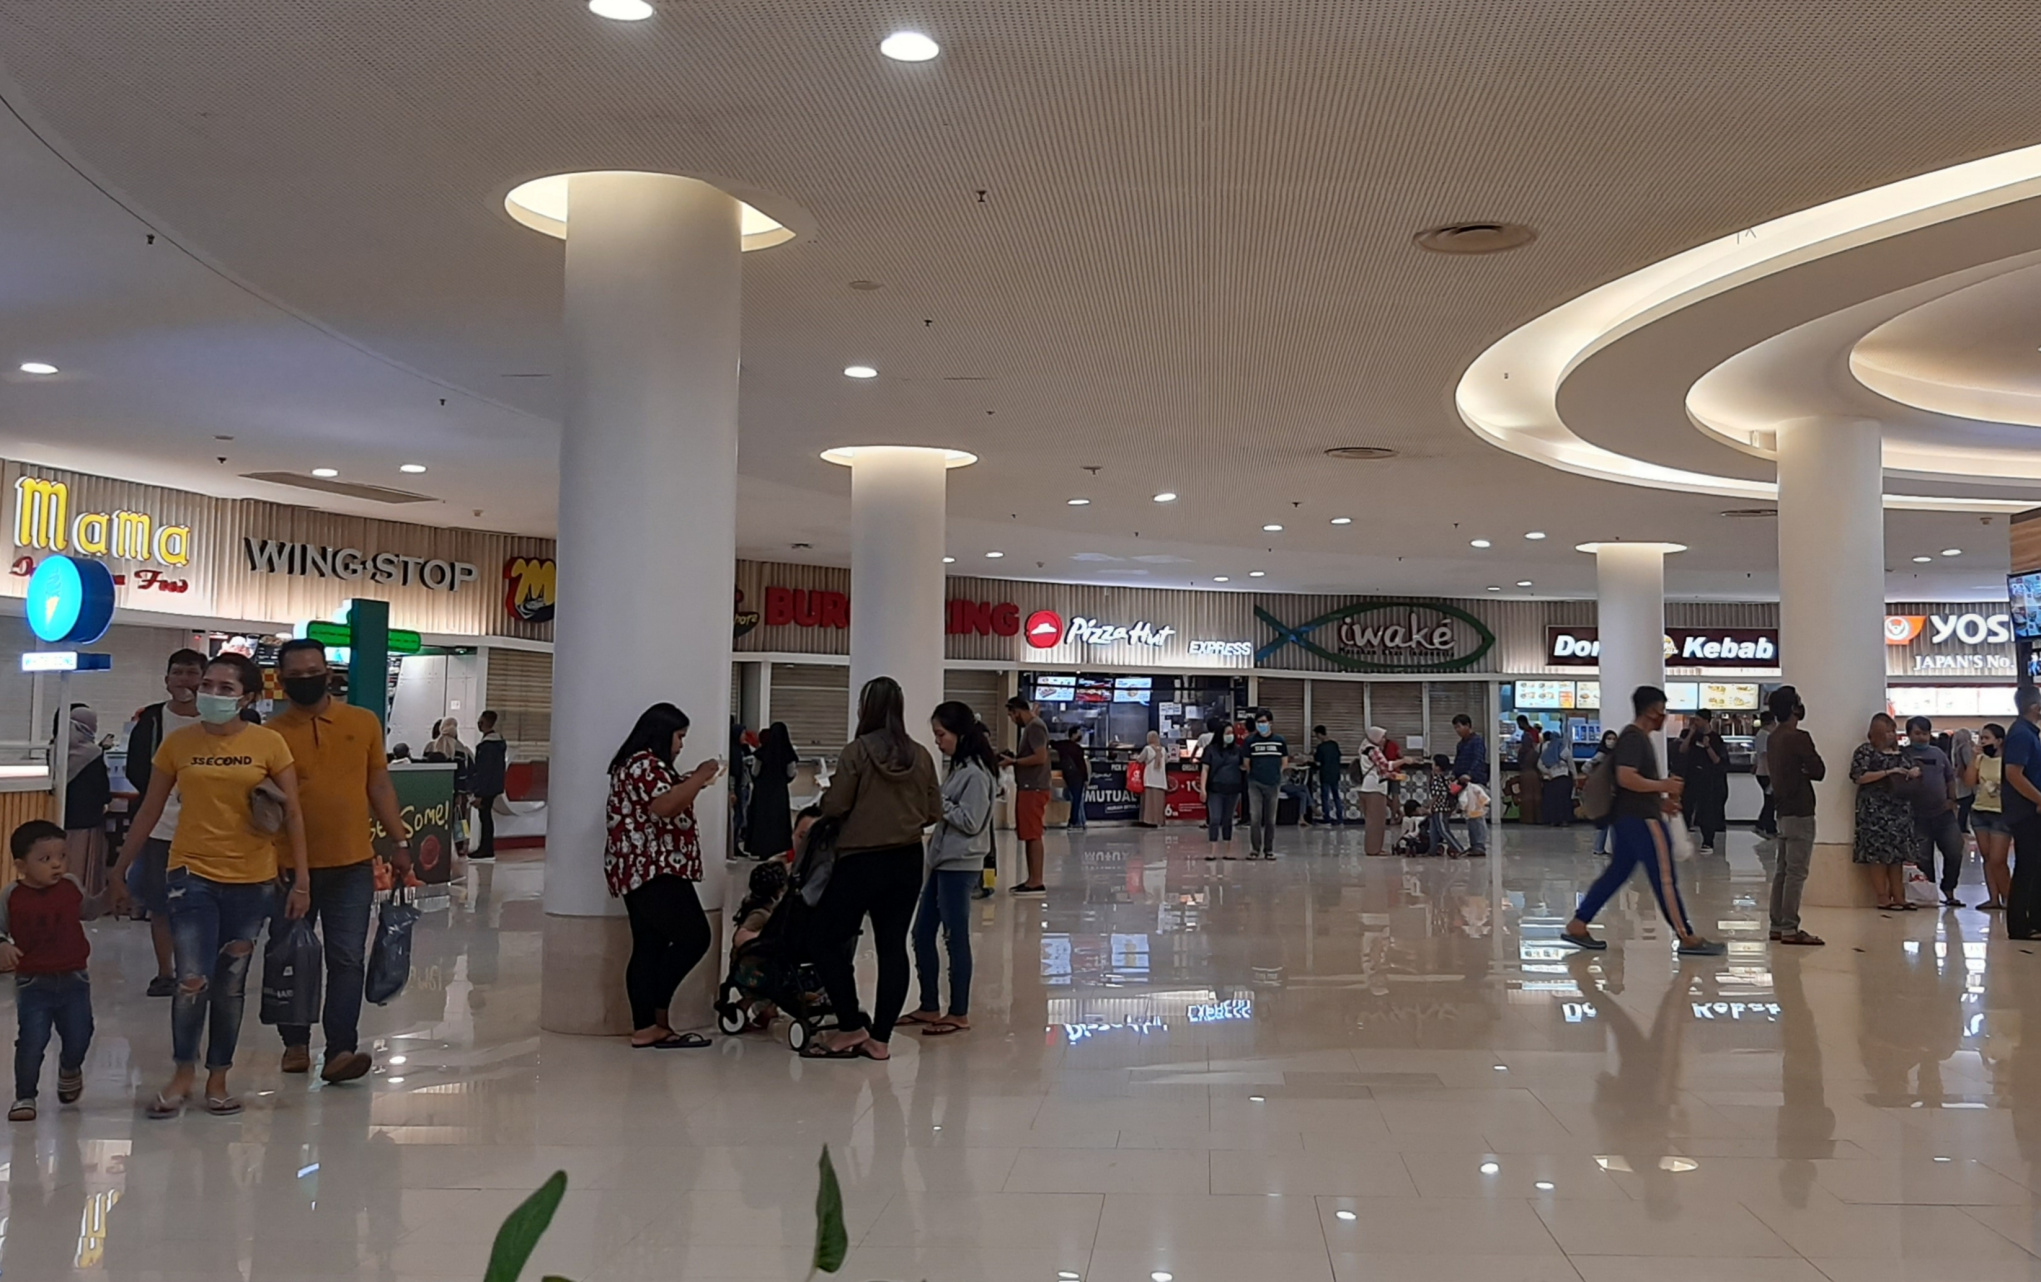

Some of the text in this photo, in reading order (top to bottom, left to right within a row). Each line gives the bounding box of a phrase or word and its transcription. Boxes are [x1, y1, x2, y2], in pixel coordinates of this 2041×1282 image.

[765, 586, 1020, 637] BUR ING
[1066, 617, 1176, 647] Pizza Hut
[1188, 640, 1252, 656] EXPRESS
[1682, 636, 1774, 660] Kebab
[1914, 654, 1983, 670] JAPAN'S
[399, 800, 450, 840] Some!
